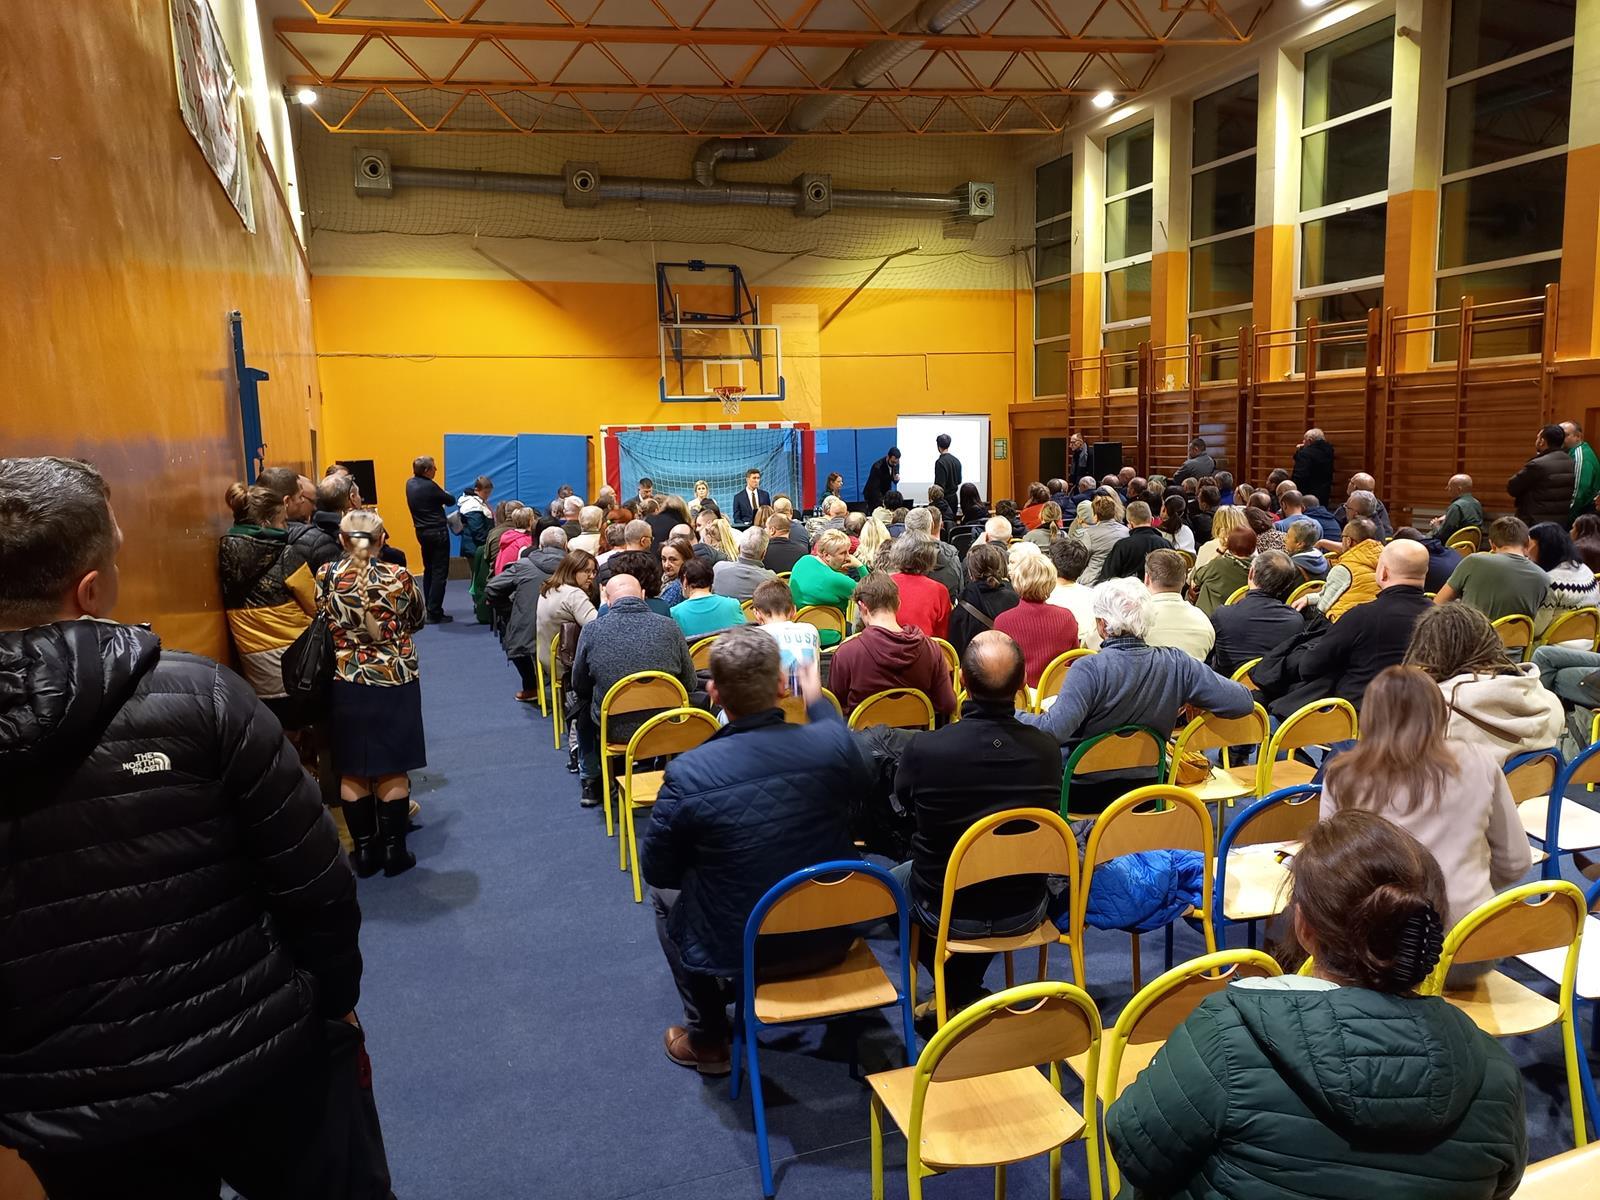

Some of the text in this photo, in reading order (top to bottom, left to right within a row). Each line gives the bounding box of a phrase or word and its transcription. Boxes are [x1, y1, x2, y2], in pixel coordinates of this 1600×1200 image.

[134, 752, 154, 761] THE
[122, 759, 155, 770] NORTH
[132, 765, 156, 775] FACE
